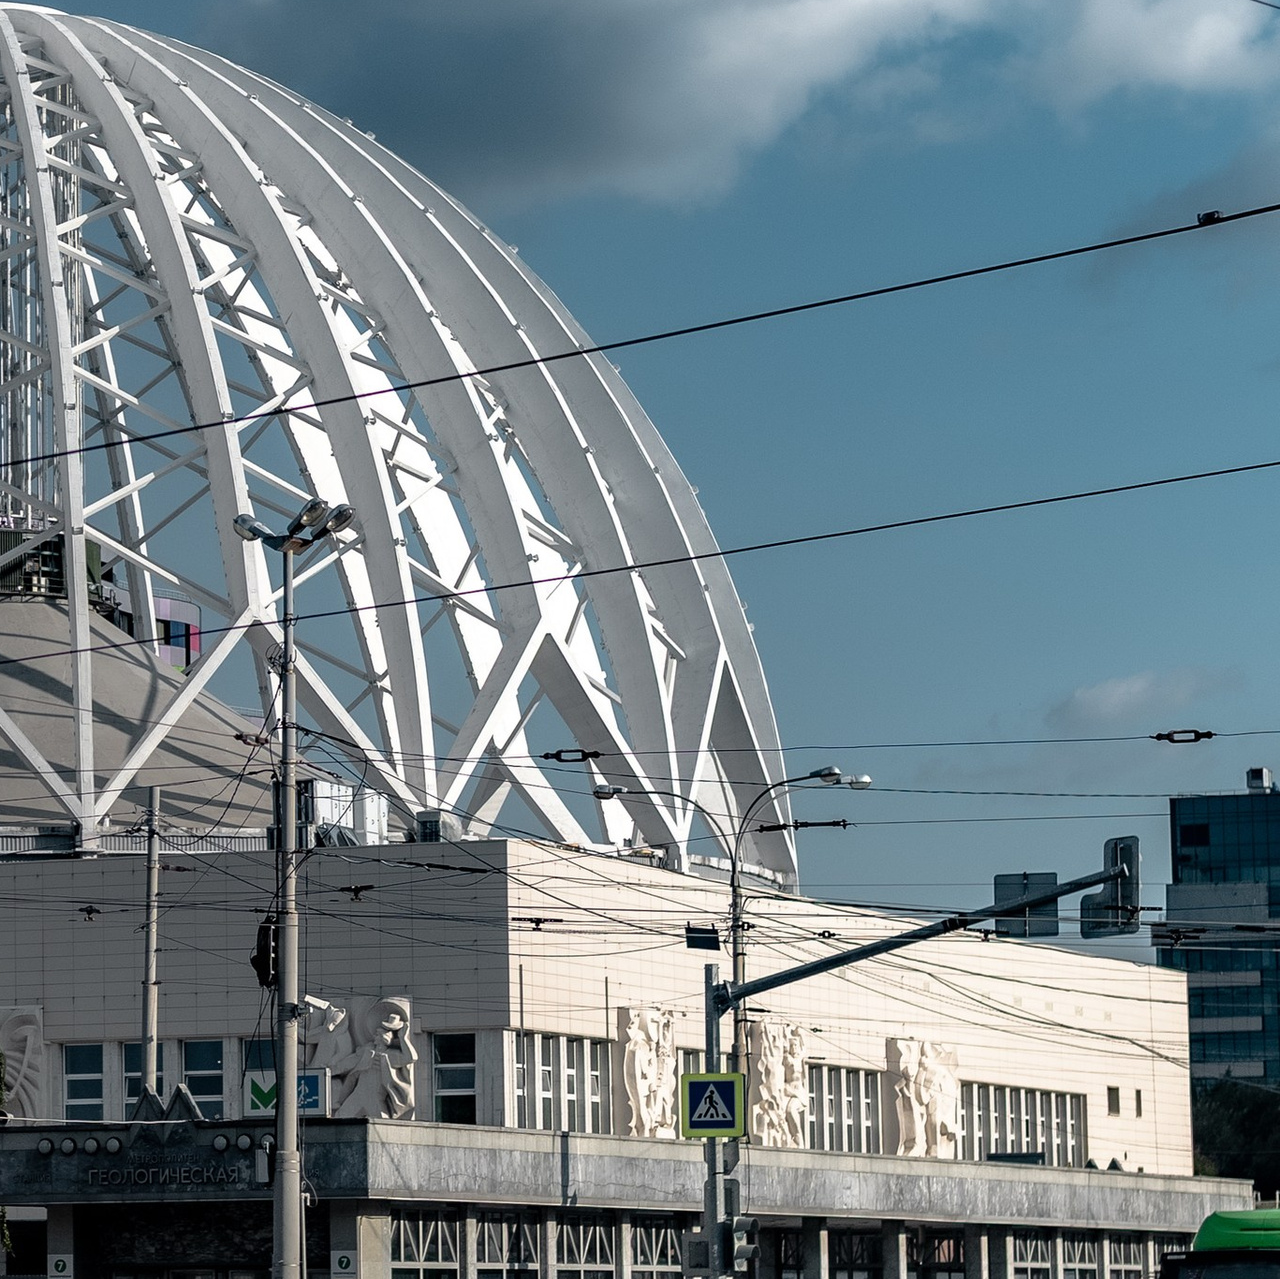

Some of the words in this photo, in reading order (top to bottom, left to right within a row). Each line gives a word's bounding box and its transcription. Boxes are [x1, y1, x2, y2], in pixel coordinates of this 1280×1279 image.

[126, 1153, 201, 1164] МЕТРОПОЛИТЕН
[88, 1167, 239, 1186] ГЕОЛОГИЧЕСКАЯ
[57, 1262, 64, 1271] 7
[341, 1257, 348, 1268] 7
